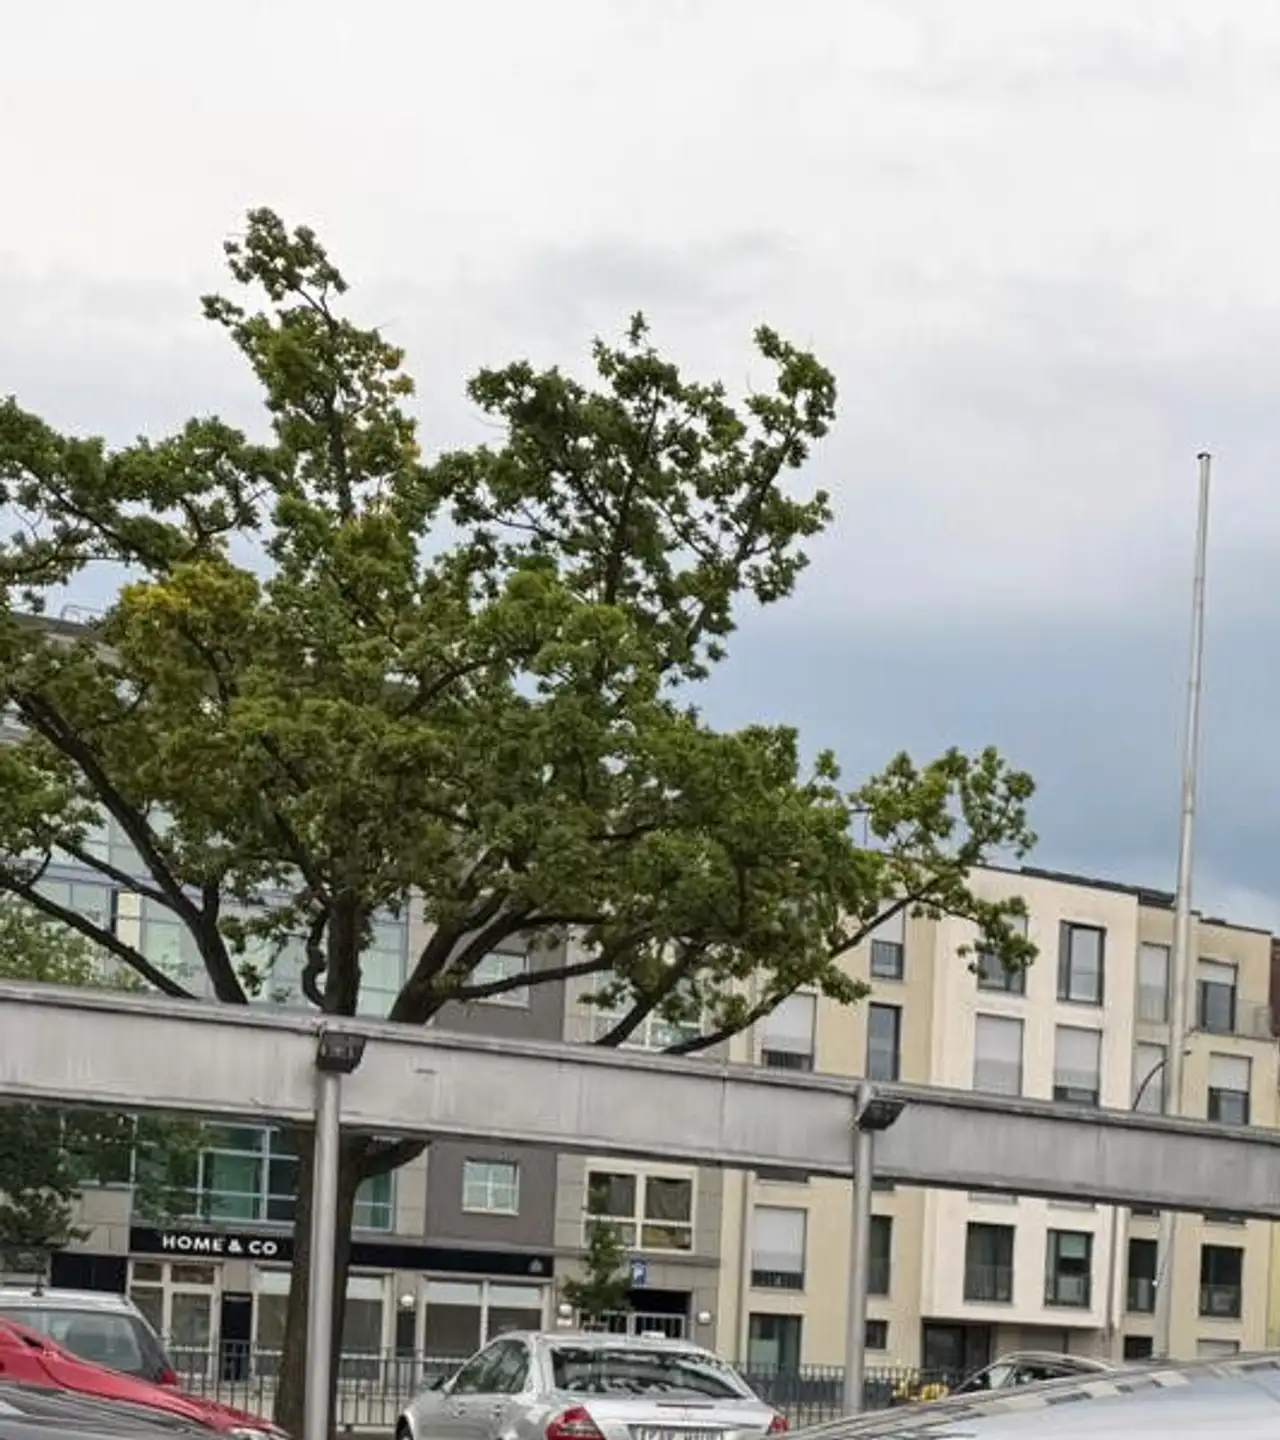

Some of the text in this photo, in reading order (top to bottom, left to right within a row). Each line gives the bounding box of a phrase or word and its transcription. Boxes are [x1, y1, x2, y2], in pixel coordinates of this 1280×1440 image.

[162, 1234, 278, 1255] HOME & CO
